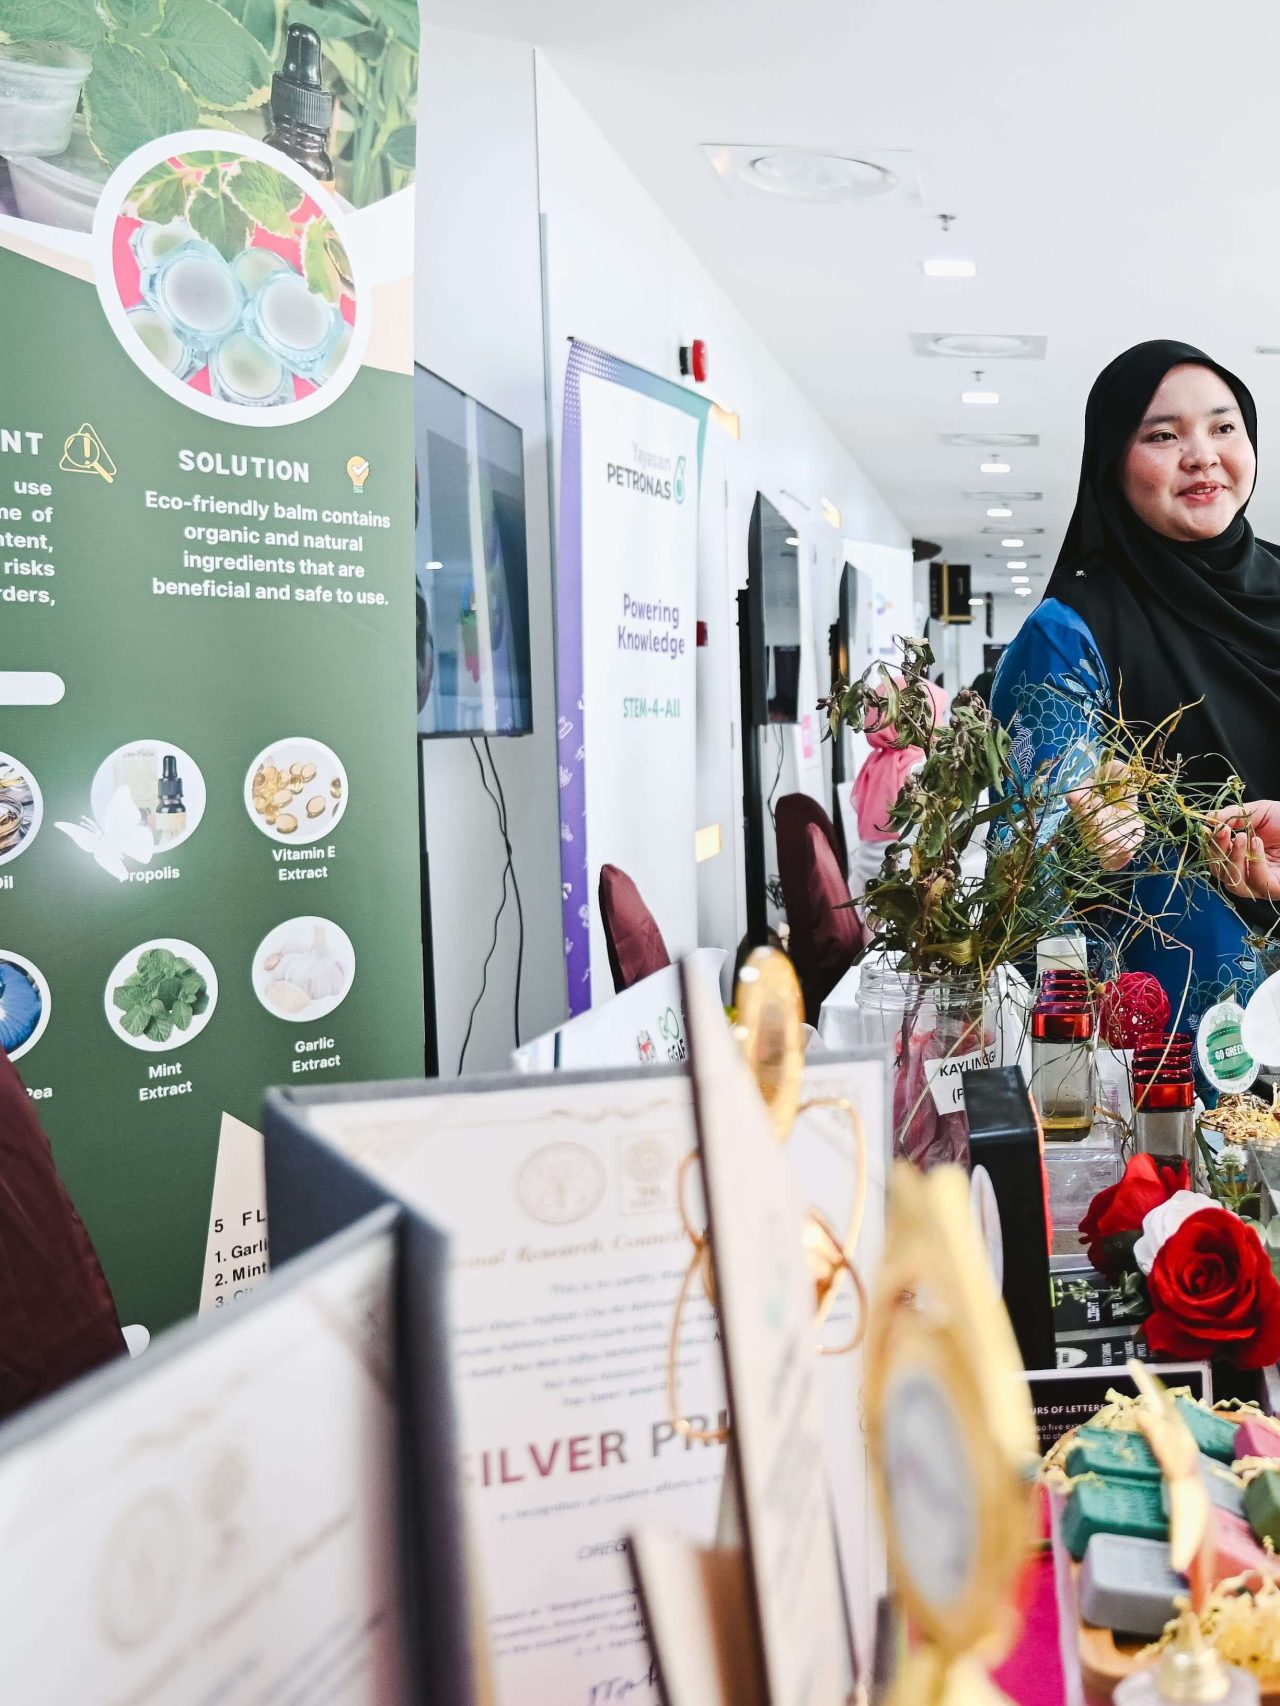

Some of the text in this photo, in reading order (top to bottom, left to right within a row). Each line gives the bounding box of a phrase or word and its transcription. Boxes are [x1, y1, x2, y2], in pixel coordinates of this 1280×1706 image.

[178, 449, 309, 483] SOLUTION
[14, 480, 52, 496] use
[607, 462, 671, 500] PETRONAS
[31, 506, 54, 523] of
[145, 490, 391, 529] Eco-friendly balm contains
[184, 525, 363, 552] organic and natural
[4, 558, 55, 577] risks
[183, 550, 365, 578] ingredients that are
[0, 586, 56, 607] ders,
[152, 577, 389, 606] beneficial and safe to use.
[623, 592, 679, 629] Powering
[618, 625, 685, 660] Knowledge
[272, 845, 336, 862] Vitamin E
[0, 875, 14, 889] il
[278, 866, 328, 881] Extract
[294, 1036, 335, 1054] Garlic
[292, 1054, 341, 1073] Extract
[1215, 1049, 1225, 1061] GO
[148, 1062, 182, 1079] Mint
[139, 1081, 193, 1102] Extract
[214, 1218, 224, 1233] 5
[214, 1250, 227, 1263] 1.
[214, 1261, 267, 1287] 2. Mint
[1051, 1405, 1064, 1414] OF
[1049, 1423, 1063, 1431] five
[479, 1430, 628, 1487] ILVER
